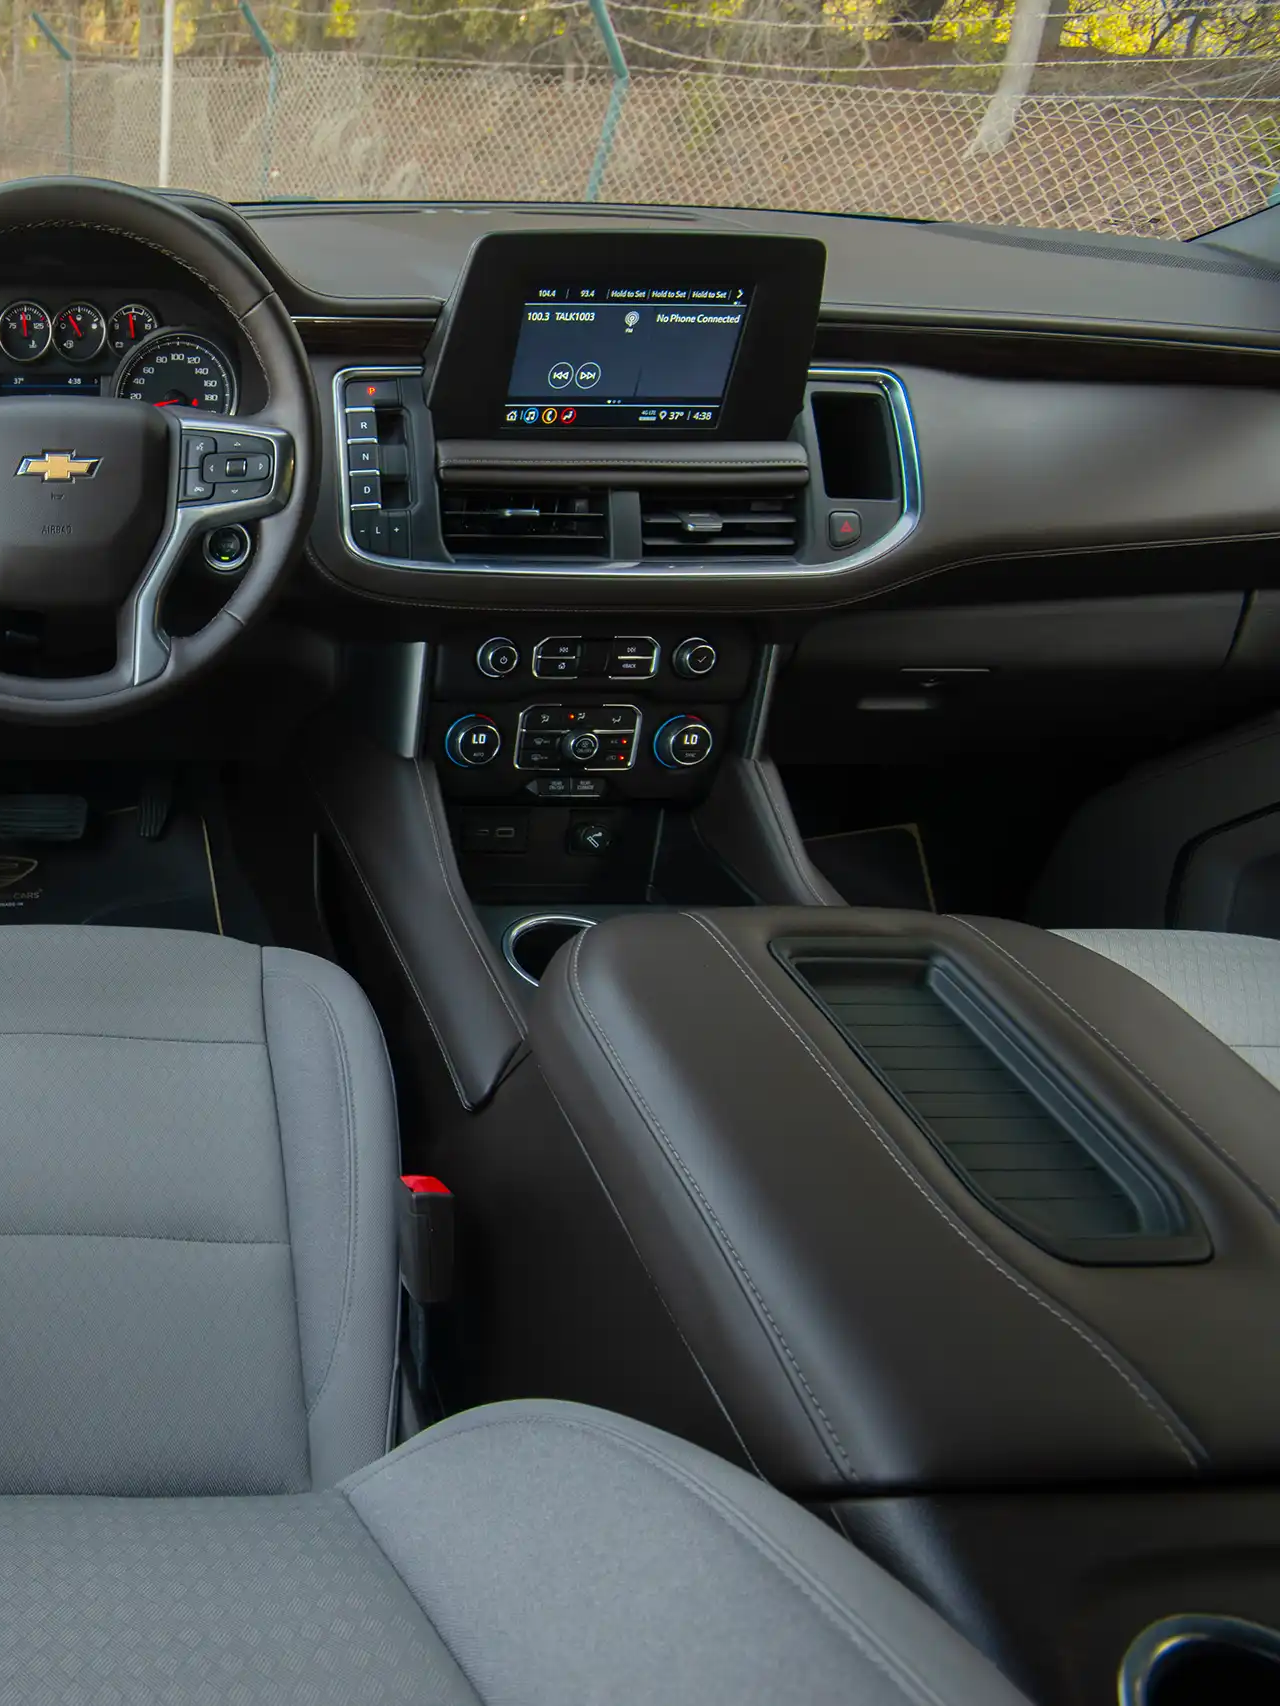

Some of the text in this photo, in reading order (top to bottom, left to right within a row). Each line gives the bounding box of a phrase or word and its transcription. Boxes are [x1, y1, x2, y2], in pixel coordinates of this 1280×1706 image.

[538, 289, 557, 298] 104.4
[580, 289, 596, 298] 93.4
[611, 289, 646, 298] Hold to Set
[651, 289, 687, 299] Hold to Set
[692, 290, 727, 299] Hold to Set
[527, 311, 596, 322] 100.3 TALK1003
[656, 313, 741, 324] No Phone Connected
[155, 355, 168, 364] 80
[170, 353, 185, 361] 100
[186, 356, 201, 365] 120
[142, 366, 155, 374] 60
[194, 367, 209, 375] 140
[67, 377, 82, 385] 4:38
[132, 377, 145, 385] 40
[203, 379, 218, 388] 160
[368, 386, 376, 395] P
[129, 392, 142, 400] 20
[204, 393, 219, 402] 180
[692, 411, 713, 421] 4:38
[360, 421, 368, 430] R
[362, 453, 370, 461] N
[364, 486, 371, 494] D
[375, 526, 381, 535] L
[471, 733, 487, 745] LO
[683, 733, 699, 745] LO
[13, 891, 40, 900] CARS
